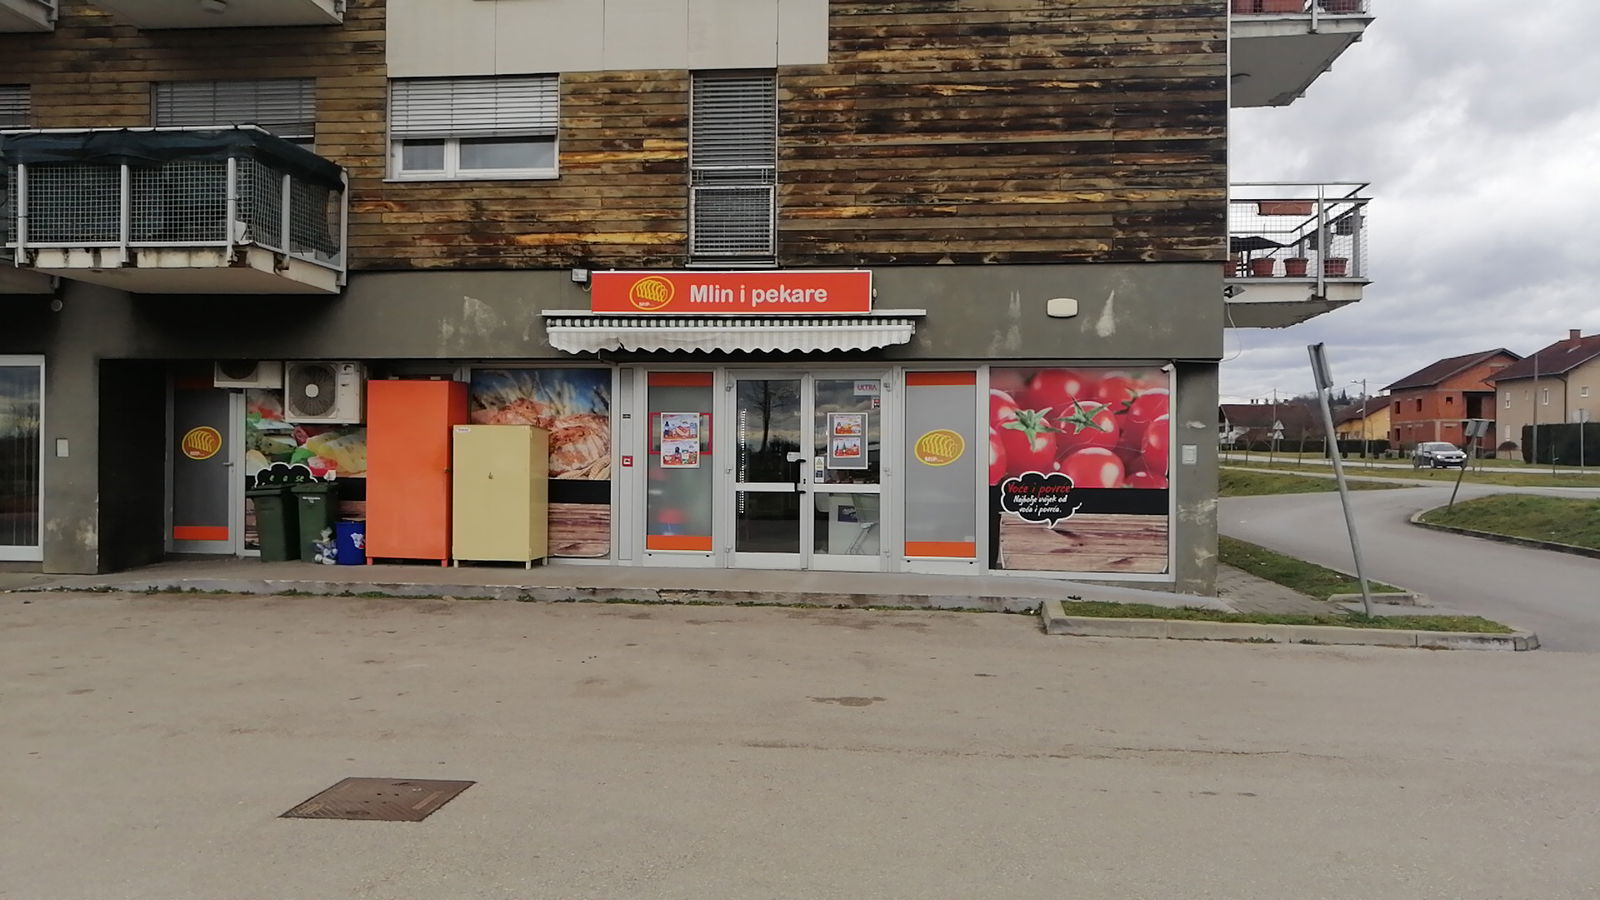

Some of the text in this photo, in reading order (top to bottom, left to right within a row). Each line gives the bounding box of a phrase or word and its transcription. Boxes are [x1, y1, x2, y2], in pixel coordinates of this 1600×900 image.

[690, 285, 828, 307] Mlin i pekare
[1058, 494, 1068, 503] od
